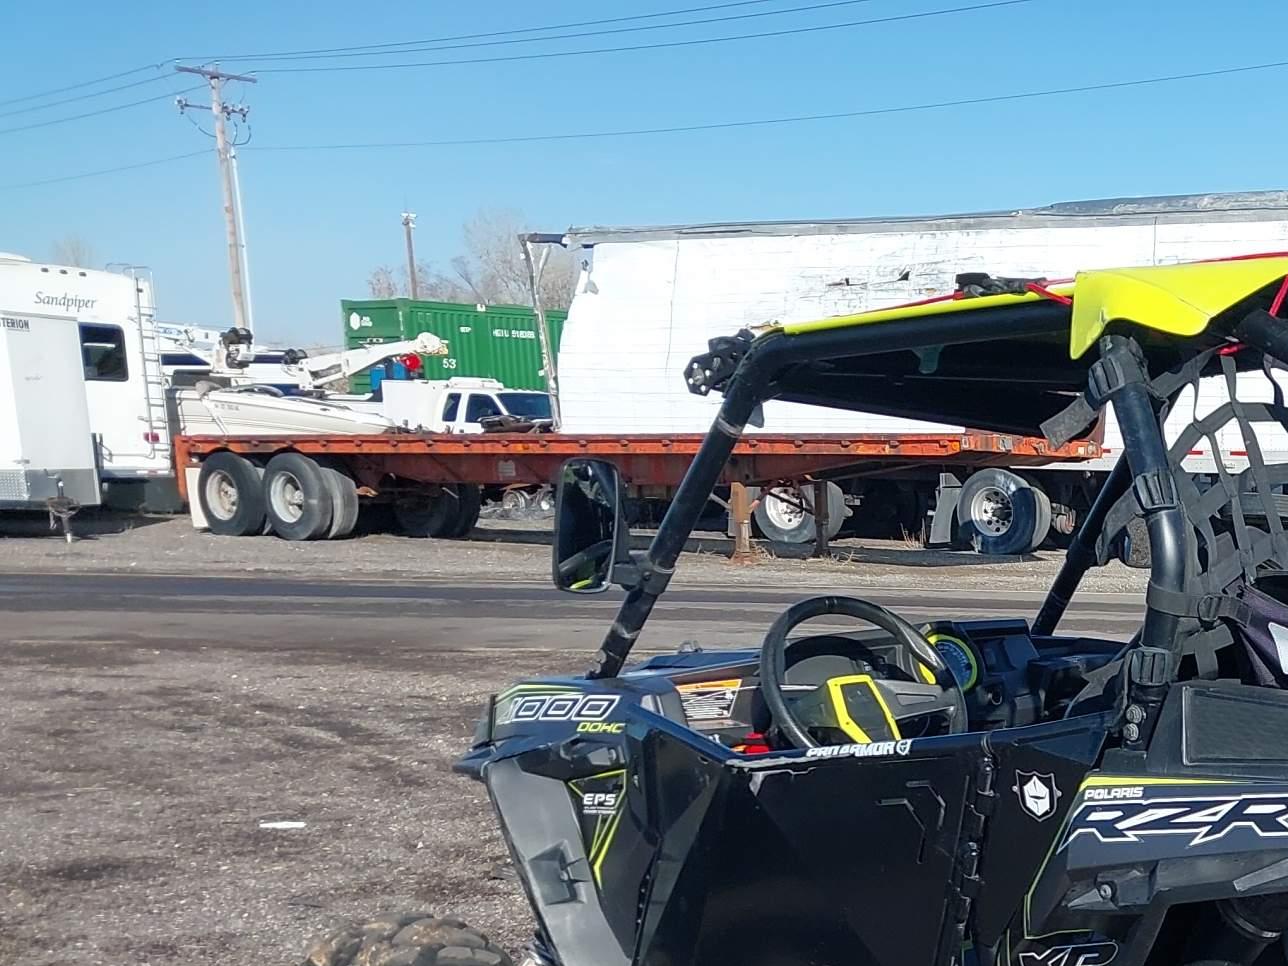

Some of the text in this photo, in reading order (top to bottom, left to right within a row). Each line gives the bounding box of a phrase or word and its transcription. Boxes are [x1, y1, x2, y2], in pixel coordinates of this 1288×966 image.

[34, 291, 96, 312] Sandpiper
[576, 722, 626, 733] DOHC
[583, 793, 617, 806] EPS
[1084, 787, 1144, 800] POLARIS
